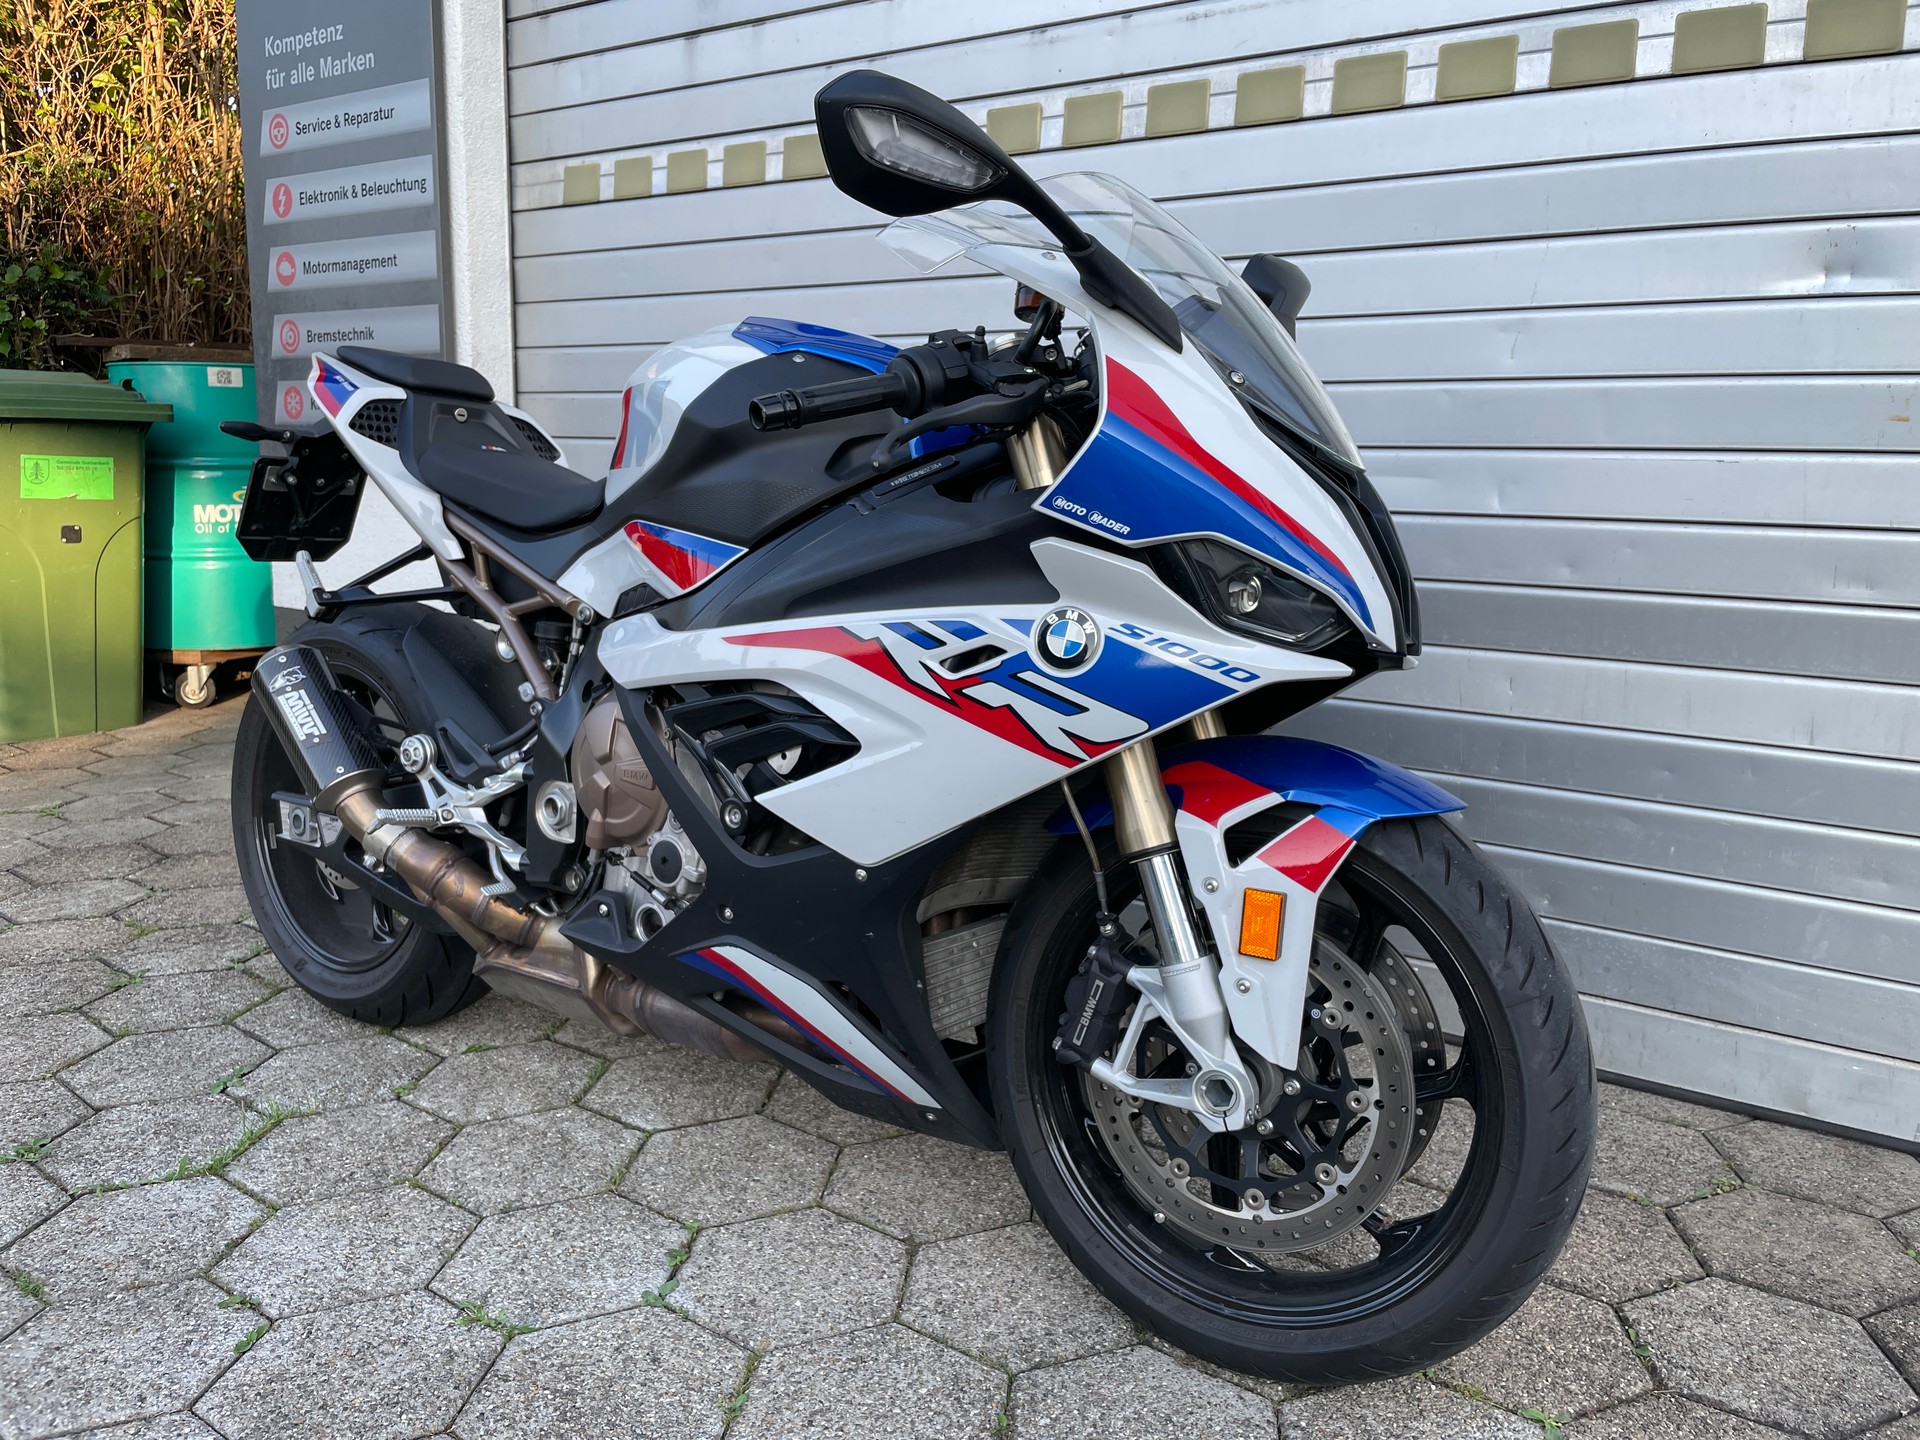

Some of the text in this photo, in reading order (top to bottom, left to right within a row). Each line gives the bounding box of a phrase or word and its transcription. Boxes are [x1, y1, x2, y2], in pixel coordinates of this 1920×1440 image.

[265, 24, 343, 57] Kompetenz
[266, 51, 375, 90] für alle Marken
[295, 106, 395, 135] Service & Reparatur
[299, 178, 427, 206] Elektronik & Beleuchtung
[303, 254, 398, 275] Motormanagement
[306, 326, 375, 343] Bremstechnik
[195, 523, 213, 534] Oil
[217, 523, 230, 534] of
[1052, 496, 1131, 535] MOTO MADER
[1108, 623, 1261, 683] S1000
[623, 769, 649, 781] BMW
[1080, 996, 1098, 1027] BMW
